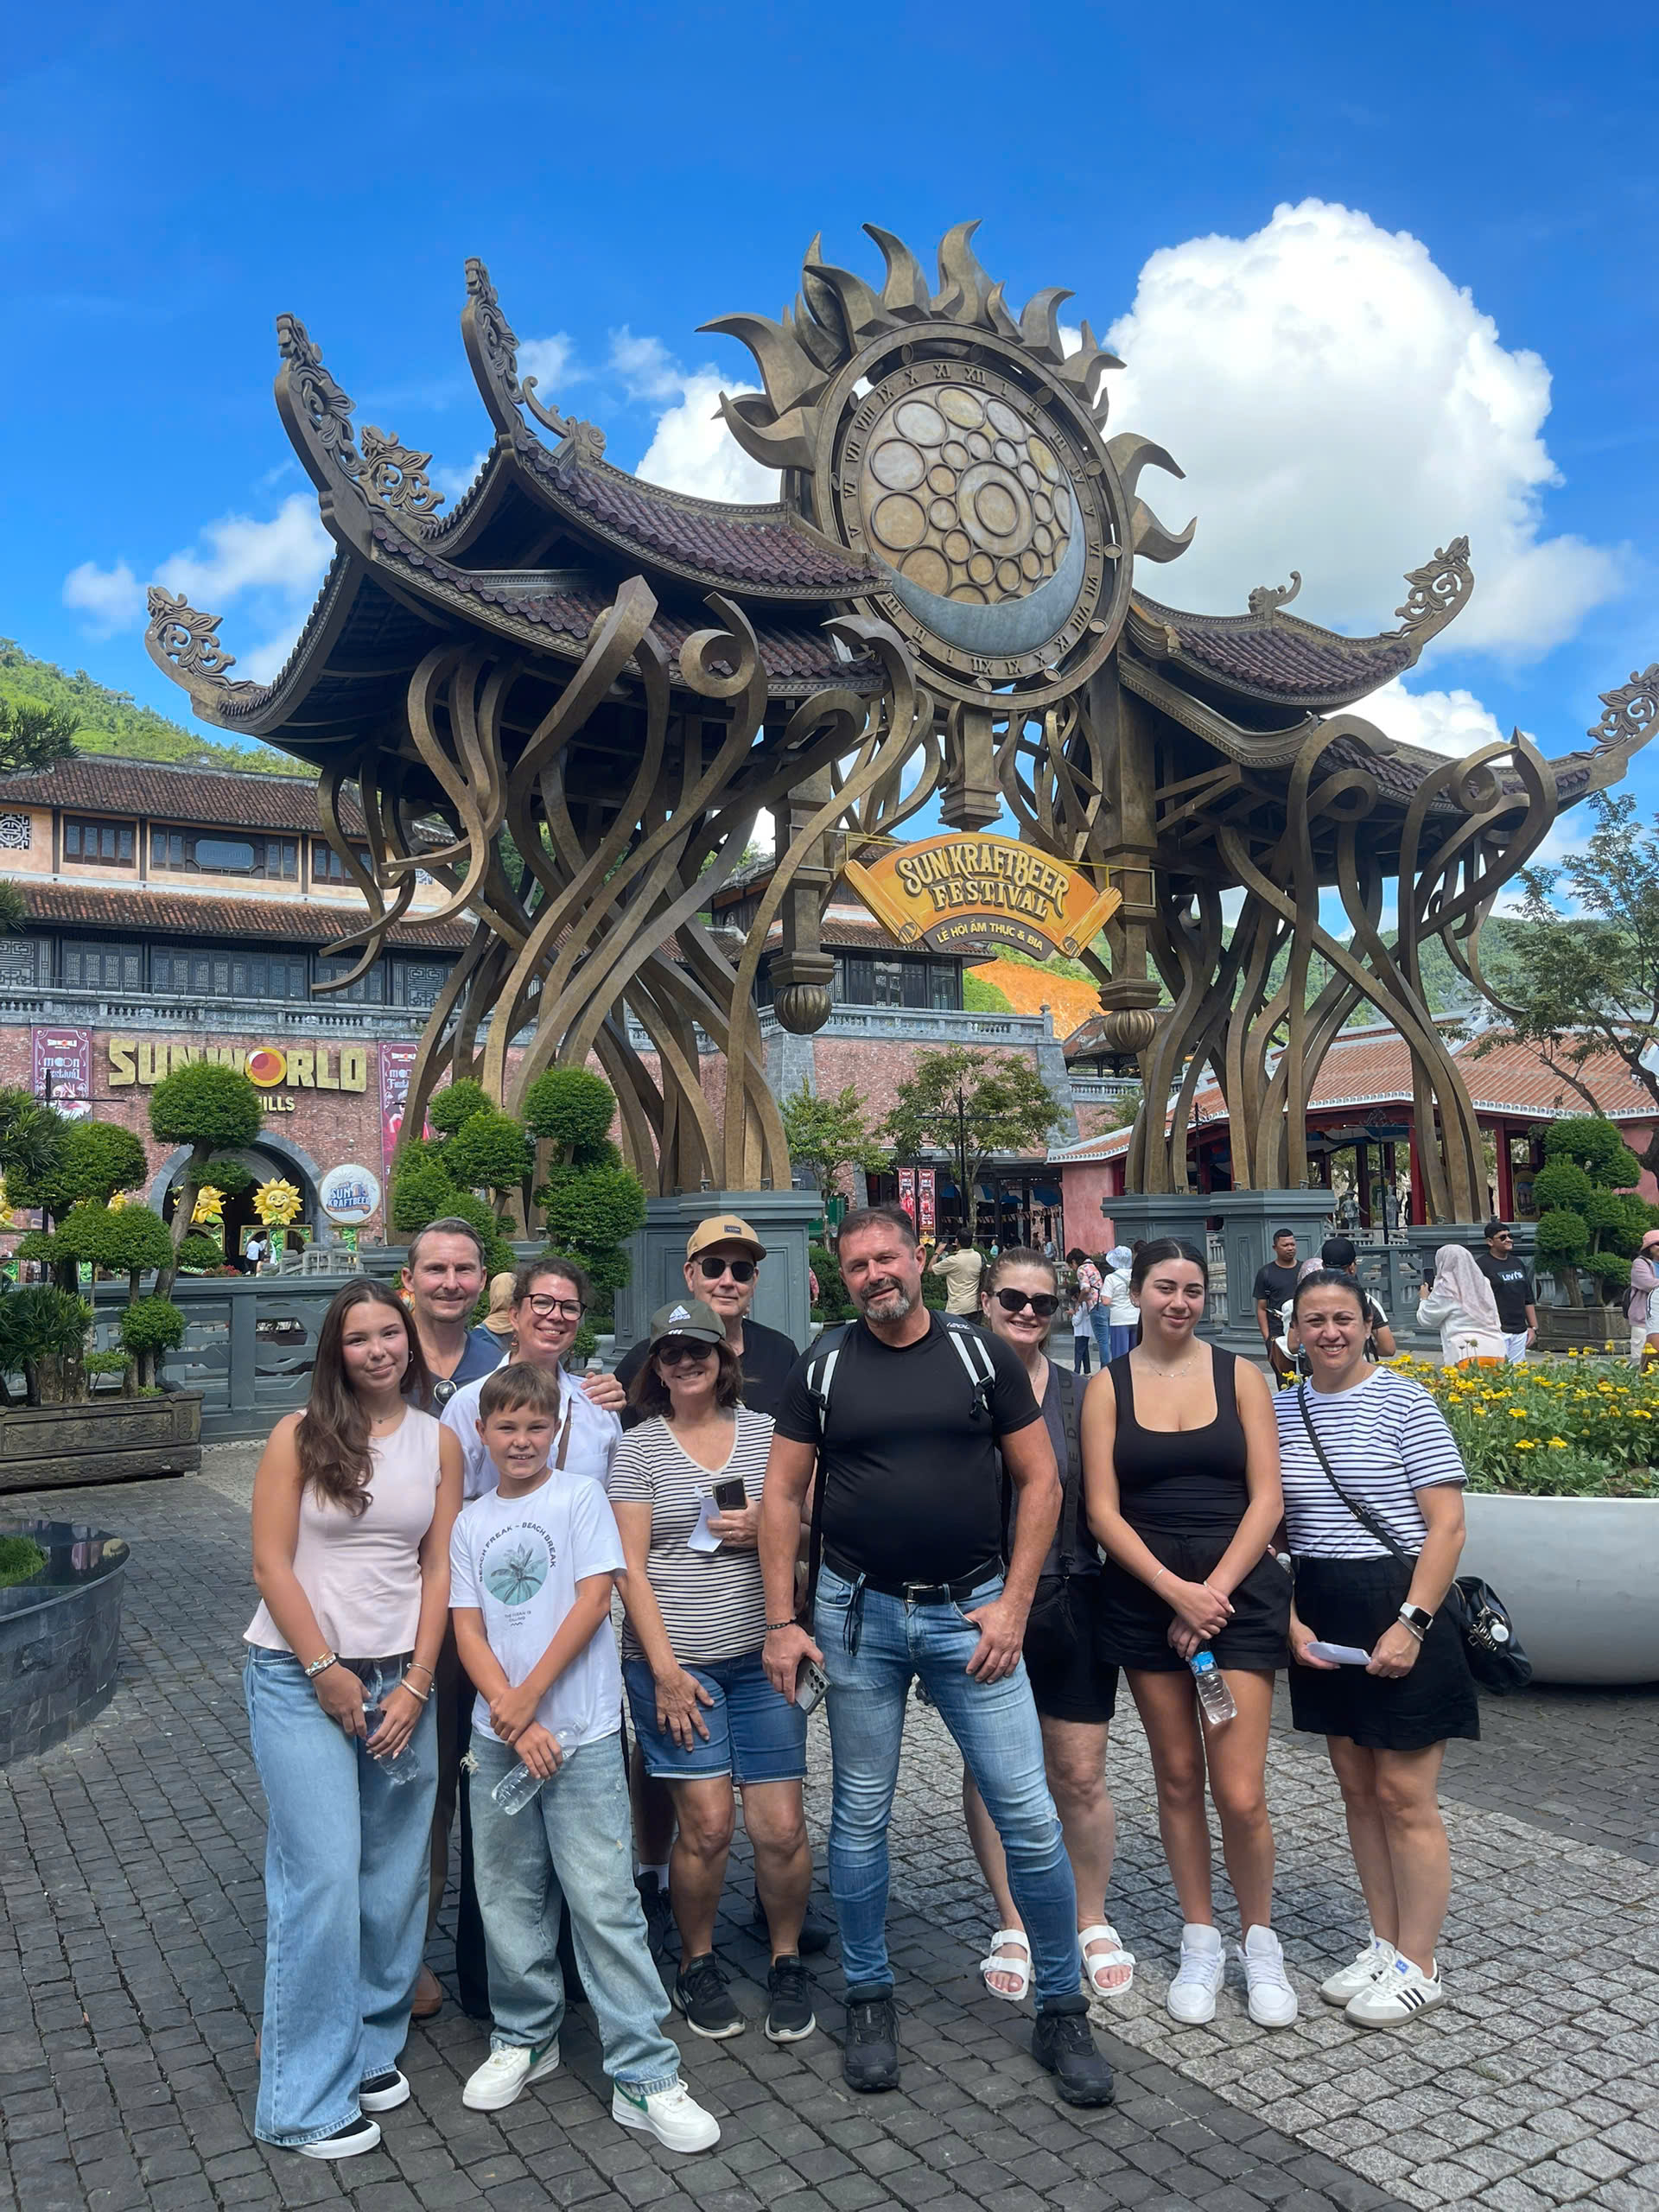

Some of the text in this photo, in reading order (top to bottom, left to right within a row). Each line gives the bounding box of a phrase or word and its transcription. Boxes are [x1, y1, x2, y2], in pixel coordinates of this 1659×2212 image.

[896, 843, 1069, 918] SUN KRAFTBEER
[930, 880, 1047, 921] FESTIVAL
[937, 927, 950, 944] LỄ
[950, 923, 969, 938] HỘI
[989, 923, 1015, 938] THỰC
[1017, 930, 1025, 941] &
[1027, 935, 1043, 950] BIA
[331, 1187, 351, 1199] SUN
[478, 1549, 487, 1583] BEACH
[485, 1526, 512, 1548] FREAK
[521, 1522, 546, 1536] BEACH
[543, 1534, 557, 1568] BREAK
